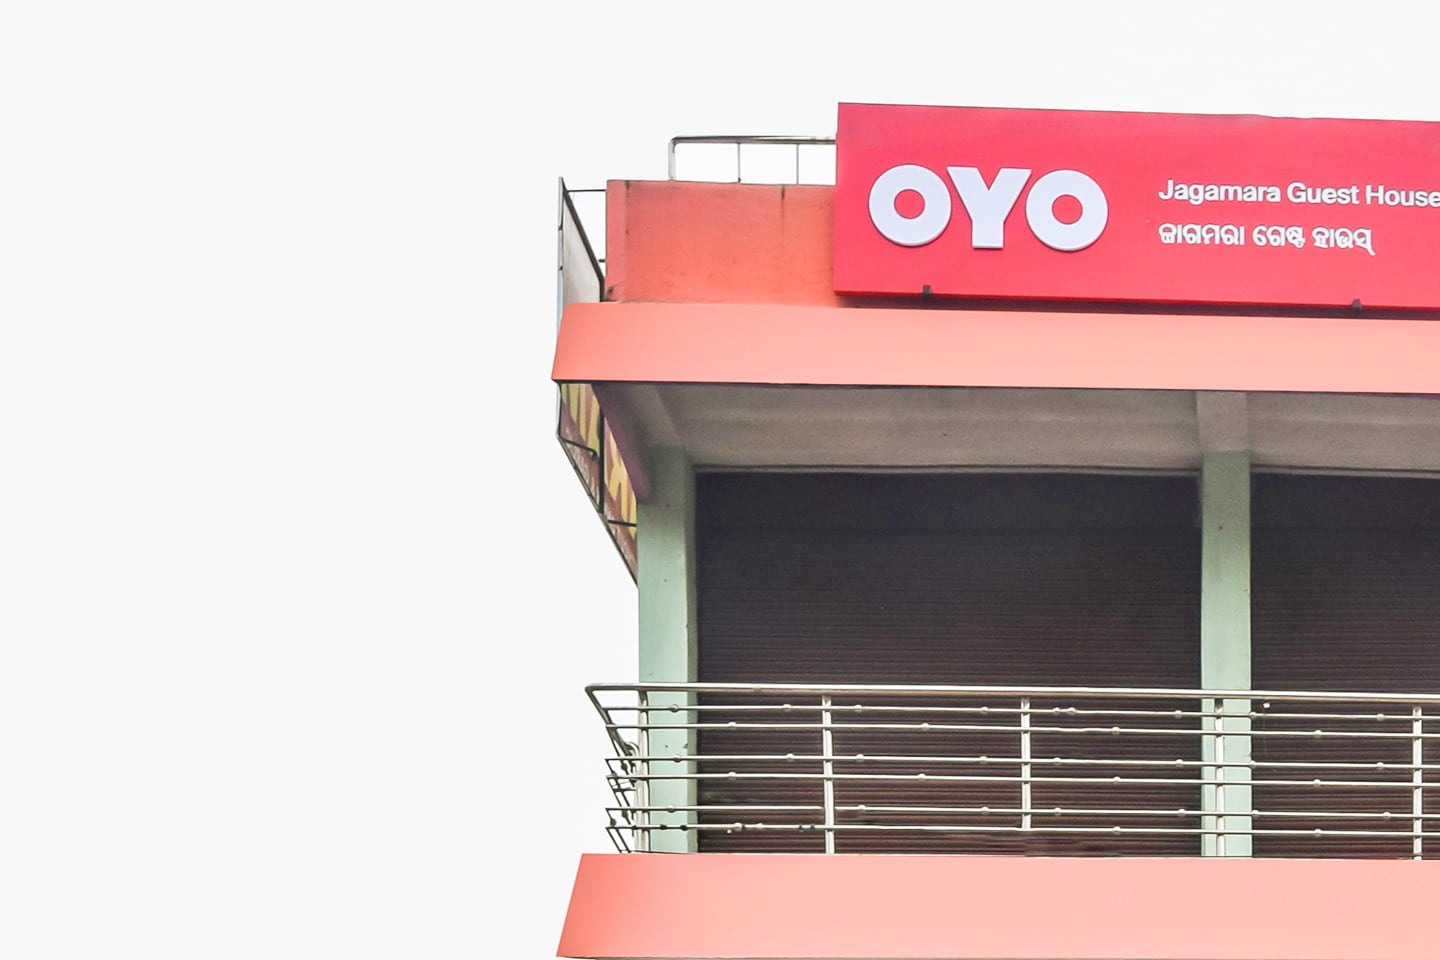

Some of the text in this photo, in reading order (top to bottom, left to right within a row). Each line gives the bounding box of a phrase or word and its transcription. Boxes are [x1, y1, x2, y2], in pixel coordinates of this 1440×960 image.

[1158, 180, 1281, 205] Jagamara
[1286, 182, 1360, 205] Guest
[869, 165, 1108, 251] OYO
[1158, 222, 1245, 246] ଜାଗମରା
